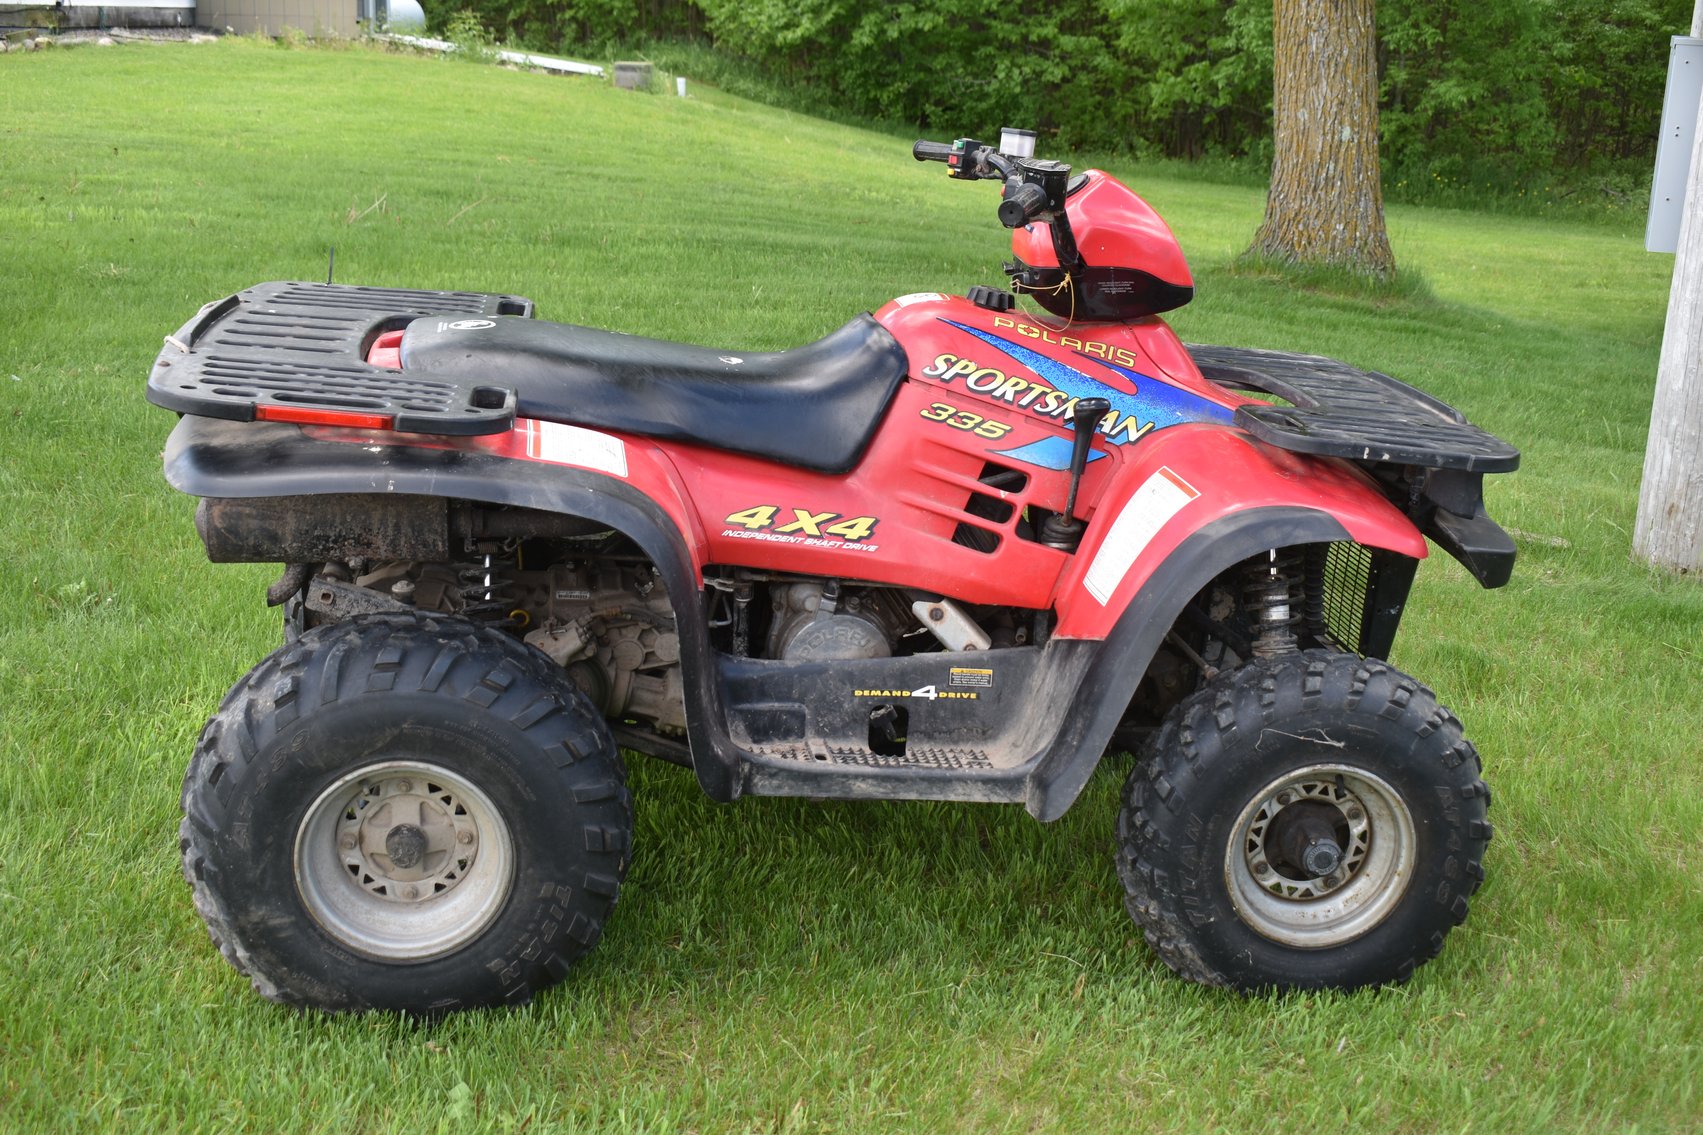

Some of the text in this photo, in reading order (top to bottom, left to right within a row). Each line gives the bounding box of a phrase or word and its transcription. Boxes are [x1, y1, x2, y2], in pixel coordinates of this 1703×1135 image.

[993, 316, 1137, 368] POLARIS
[919, 402, 1012, 440] 335
[721, 529, 879, 552] INDEPENDENT SHAFT DRIVE
[911, 685, 938, 700] 4
[497, 883, 573, 987] TITAN
